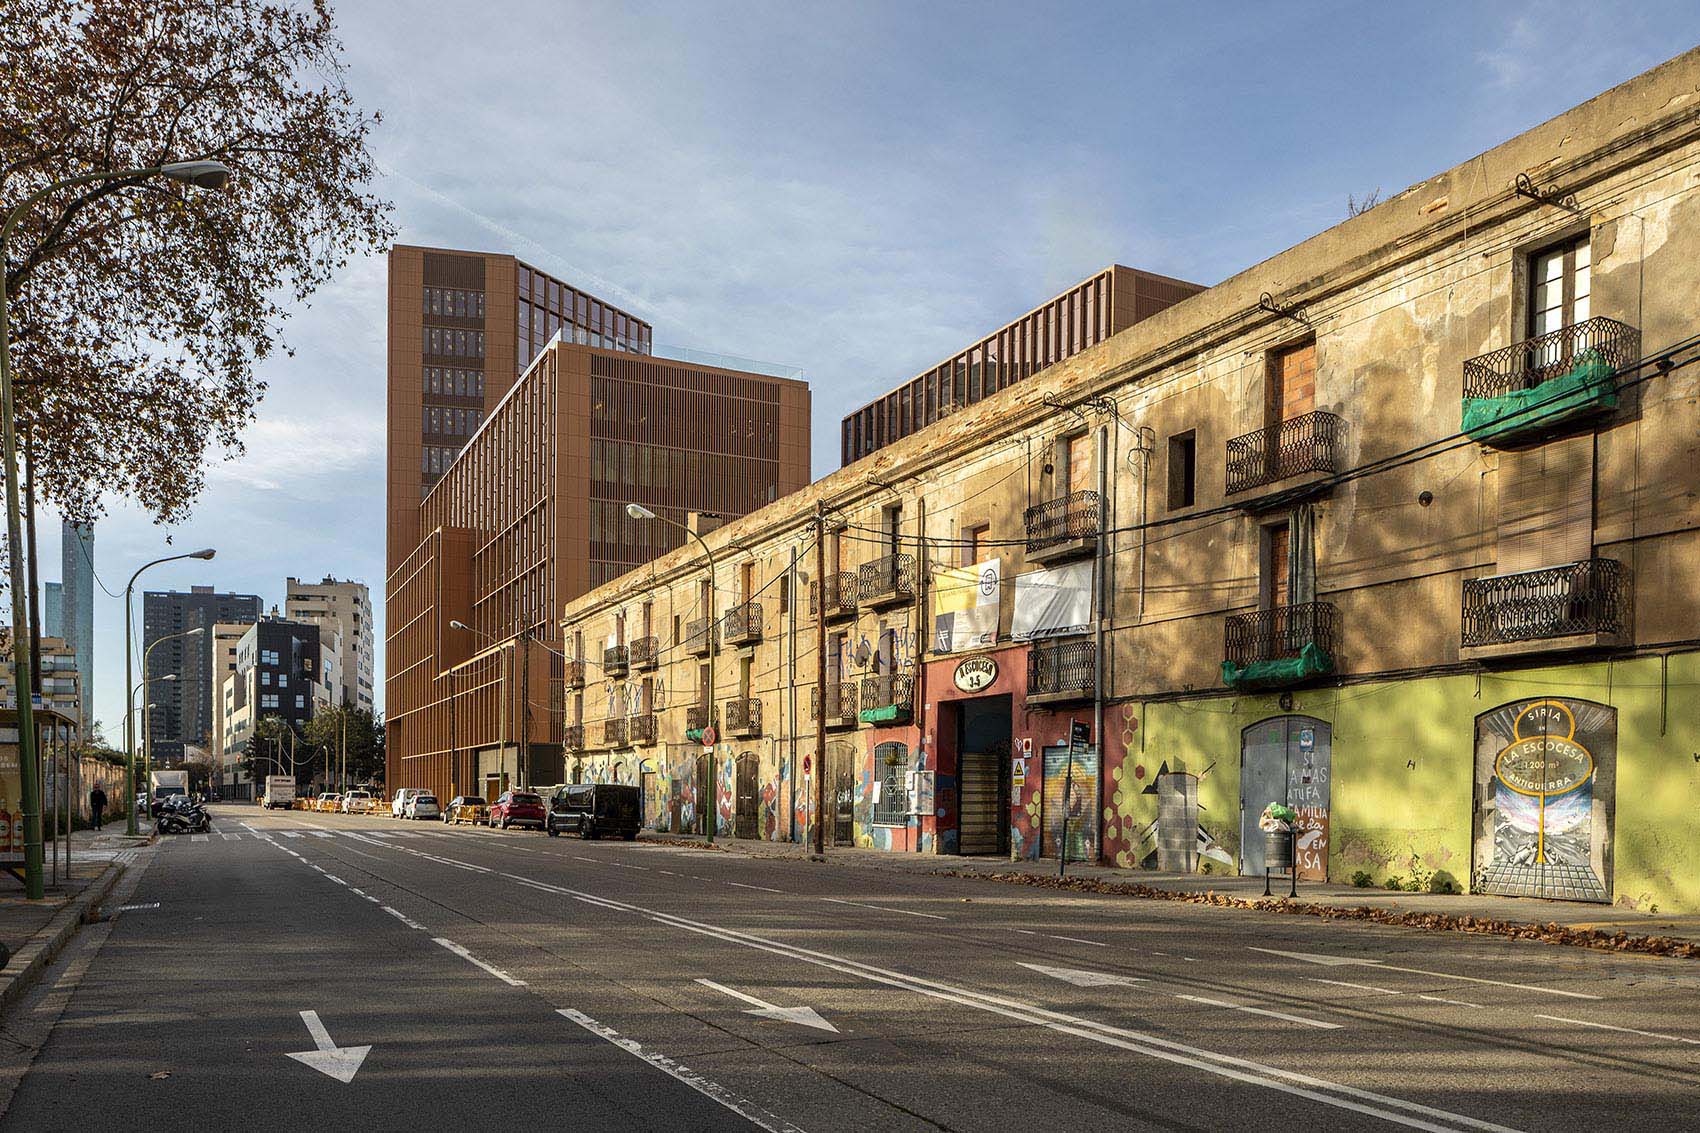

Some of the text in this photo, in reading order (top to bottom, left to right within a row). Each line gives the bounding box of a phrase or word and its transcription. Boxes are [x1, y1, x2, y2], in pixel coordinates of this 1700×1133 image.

[1528, 708, 1561, 722] SIRIA
[1504, 741, 1584, 764] LA ESCOCESA
[1525, 761, 1545, 769] 1200
[1312, 838, 1327, 850] EN
[1295, 850, 1321, 871] ASA
